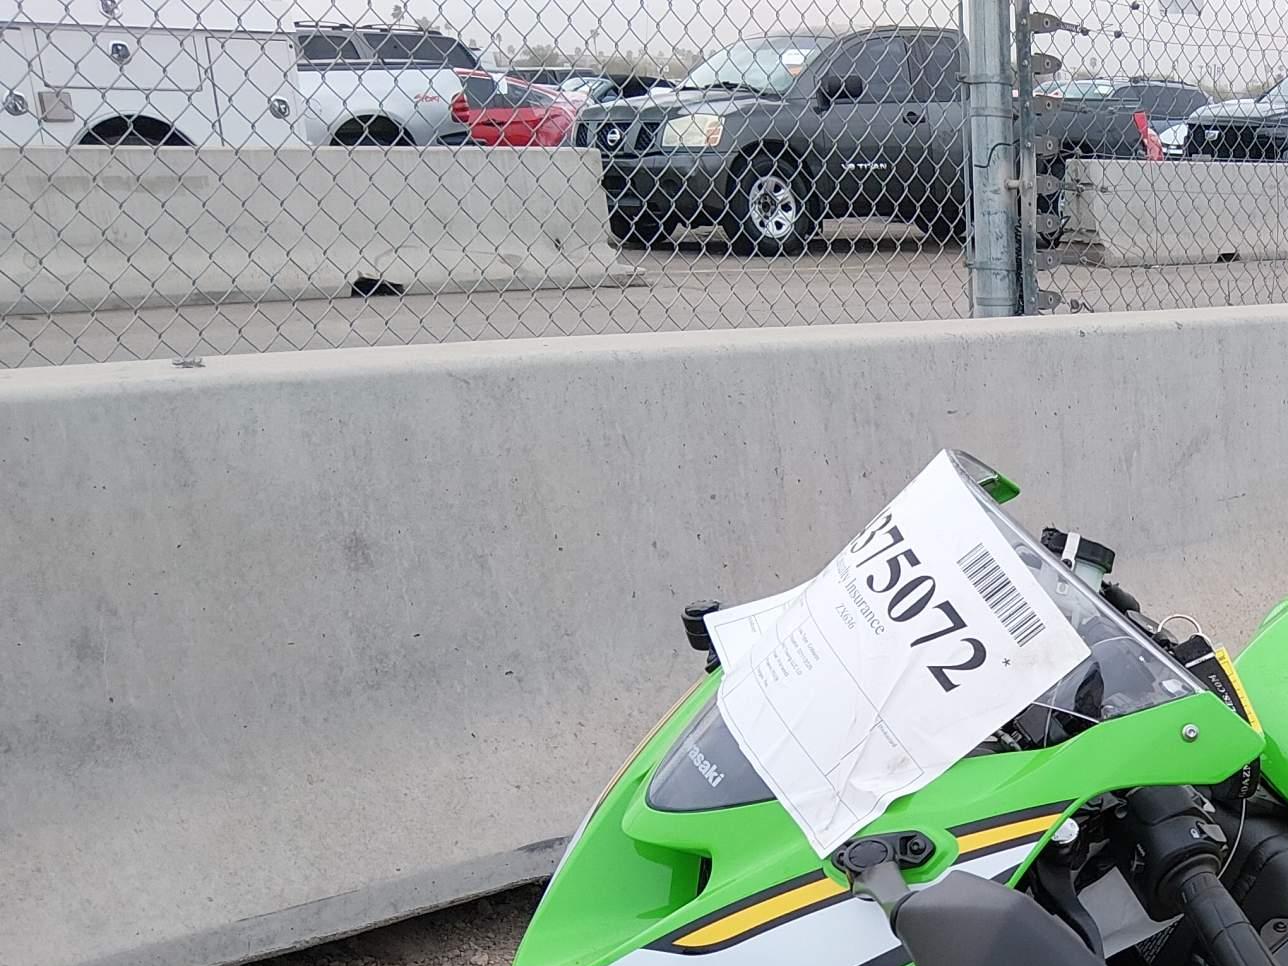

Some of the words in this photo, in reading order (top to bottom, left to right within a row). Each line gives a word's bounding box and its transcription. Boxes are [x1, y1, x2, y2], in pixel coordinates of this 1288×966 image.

[835, 602, 857, 631] ZX636
[844, 576, 886, 636] Insurance
[851, 507, 988, 693] 375072
